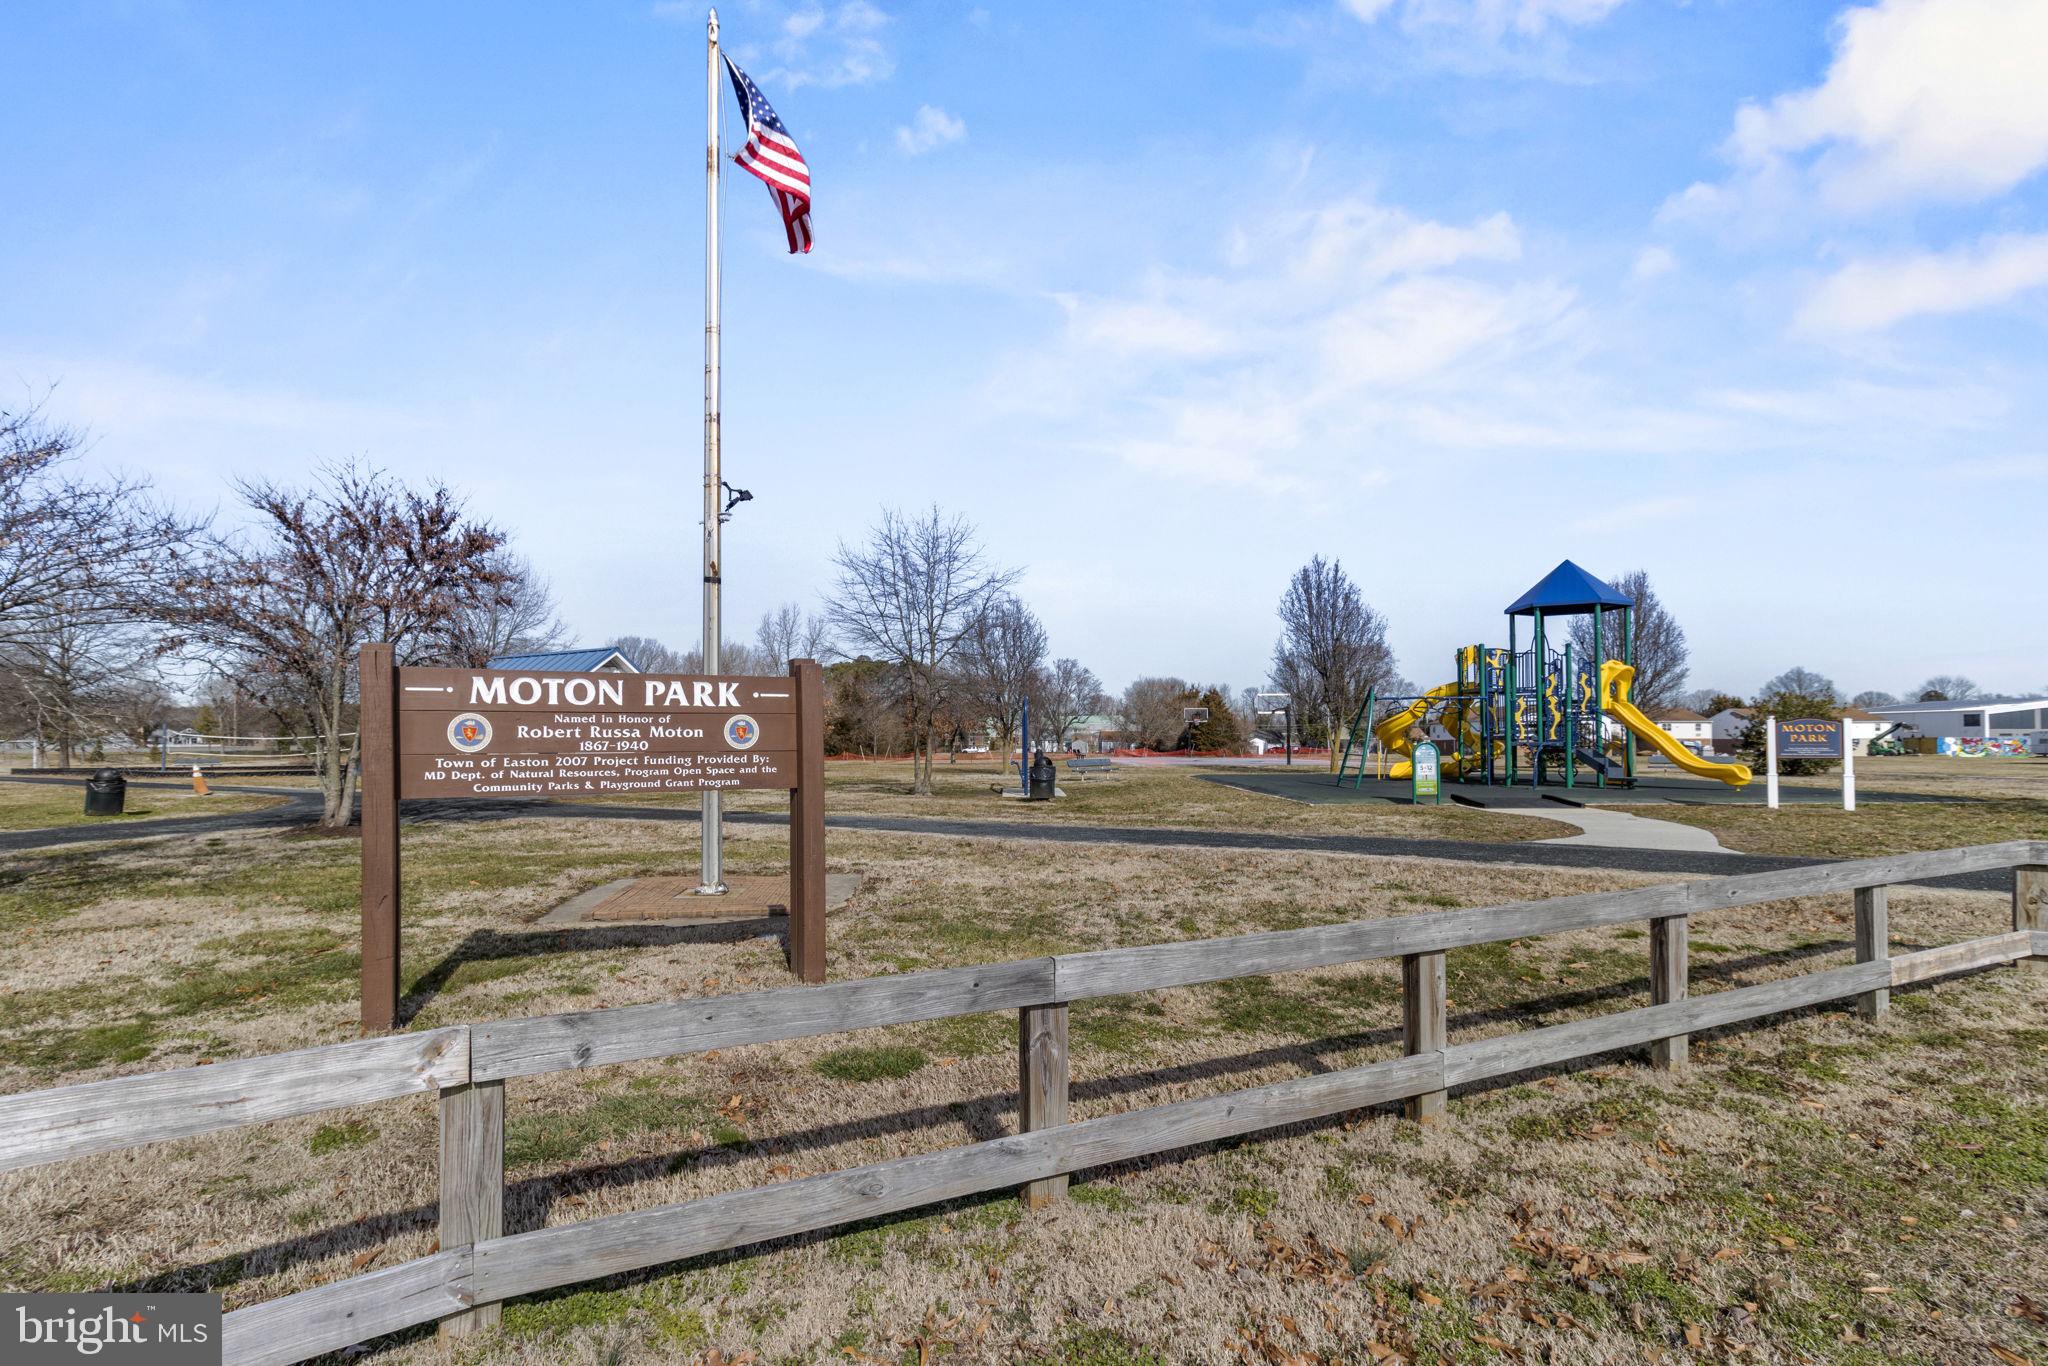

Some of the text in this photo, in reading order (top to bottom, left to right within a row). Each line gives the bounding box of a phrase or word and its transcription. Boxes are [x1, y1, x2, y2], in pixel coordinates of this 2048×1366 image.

[469, 676, 741, 707] MOTON PARK
[554, 714, 672, 724] Named in Honor of
[517, 725, 704, 739] Robert Russa Moton
[1782, 724, 1836, 732] MOTON
[1790, 734, 1828, 742] PARK
[579, 740, 649, 751] 1867-1940
[435, 754, 770, 768] Town of Easton 2007 Project Funding Provided By:
[424, 765, 778, 781] MD Dept. of Natural Resources, Program Open Space and the
[473, 777, 740, 793] Community Parks & Playground Grant Program
